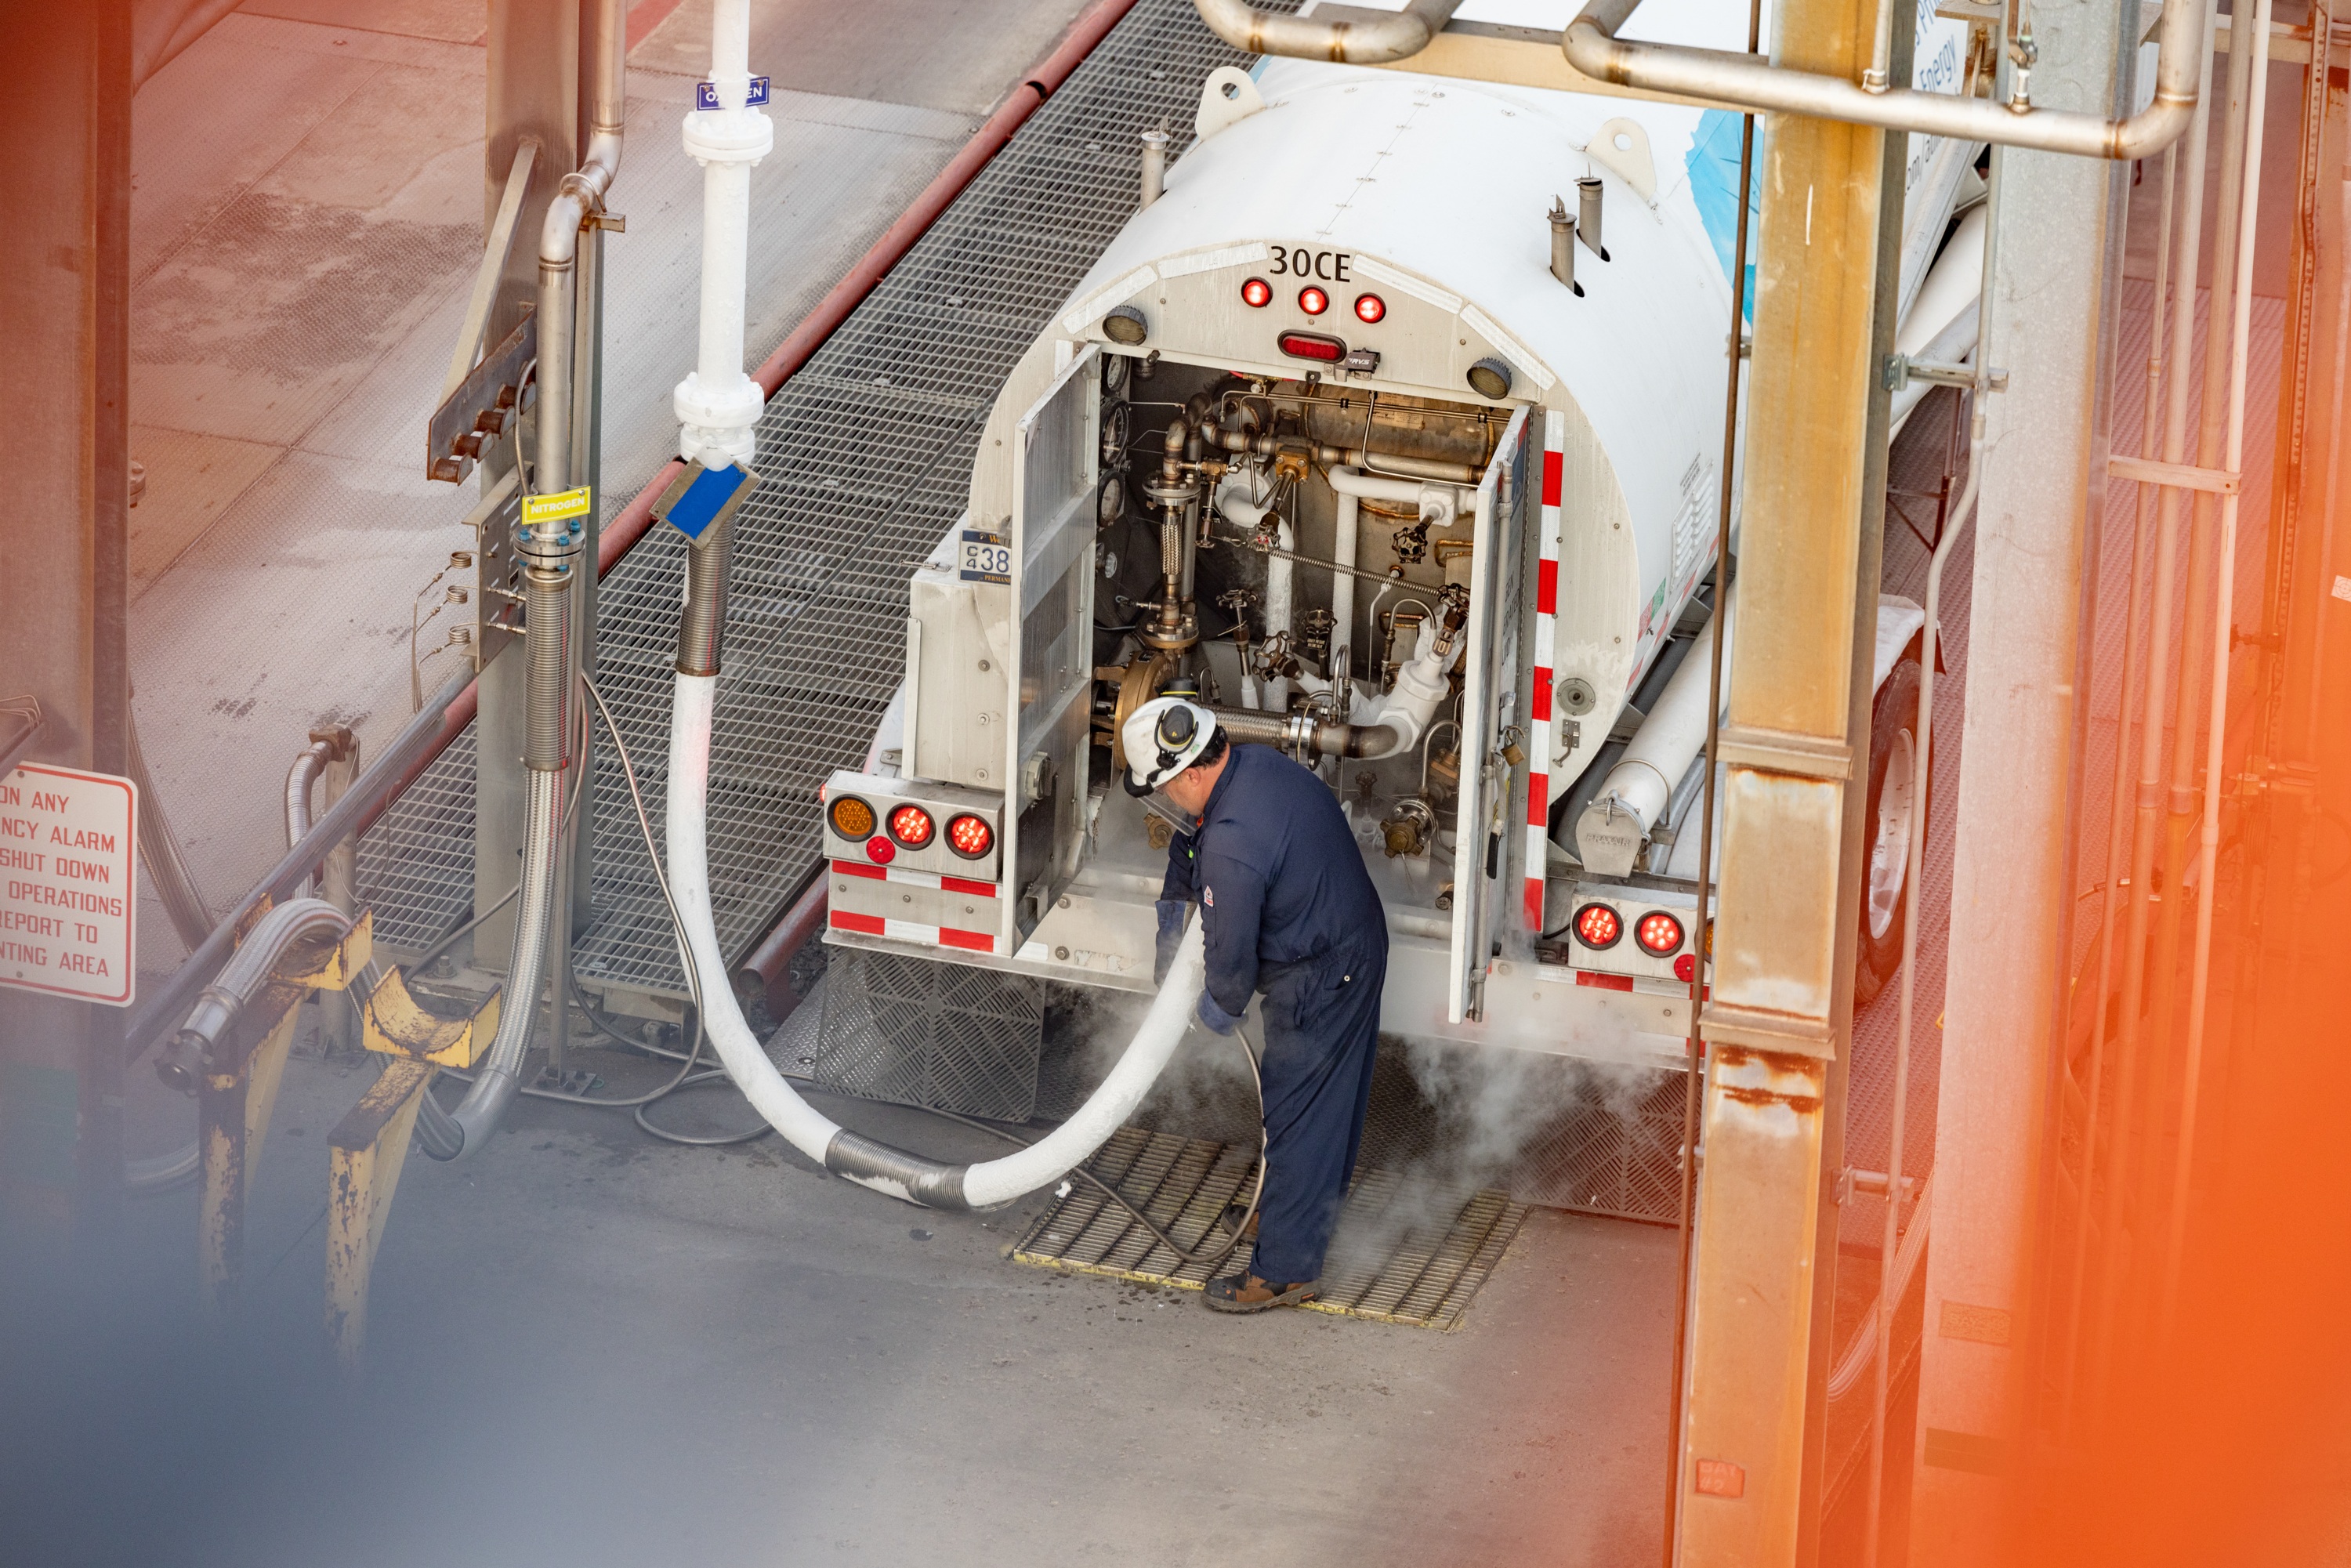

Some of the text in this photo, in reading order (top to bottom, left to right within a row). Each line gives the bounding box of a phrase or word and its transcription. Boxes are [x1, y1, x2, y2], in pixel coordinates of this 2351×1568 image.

[1270, 245, 1350, 282] 30CE
[531, 497, 585, 514] NITROGEN
[1433, 639, 1451, 655] 101
[31, 791, 70, 813] ANY
[2, 817, 115, 853] NCY ALARM
[1586, 833, 1631, 847] PRAXAIR
[0, 847, 110, 884] SHUT DOWN
[9, 880, 122, 917] OPERATIONS
[0, 910, 98, 944] EPORT TO
[59, 951, 109, 977] AREA
[1700, 1462, 1737, 1478] BAY
[1700, 1476, 1725, 1492] #2
